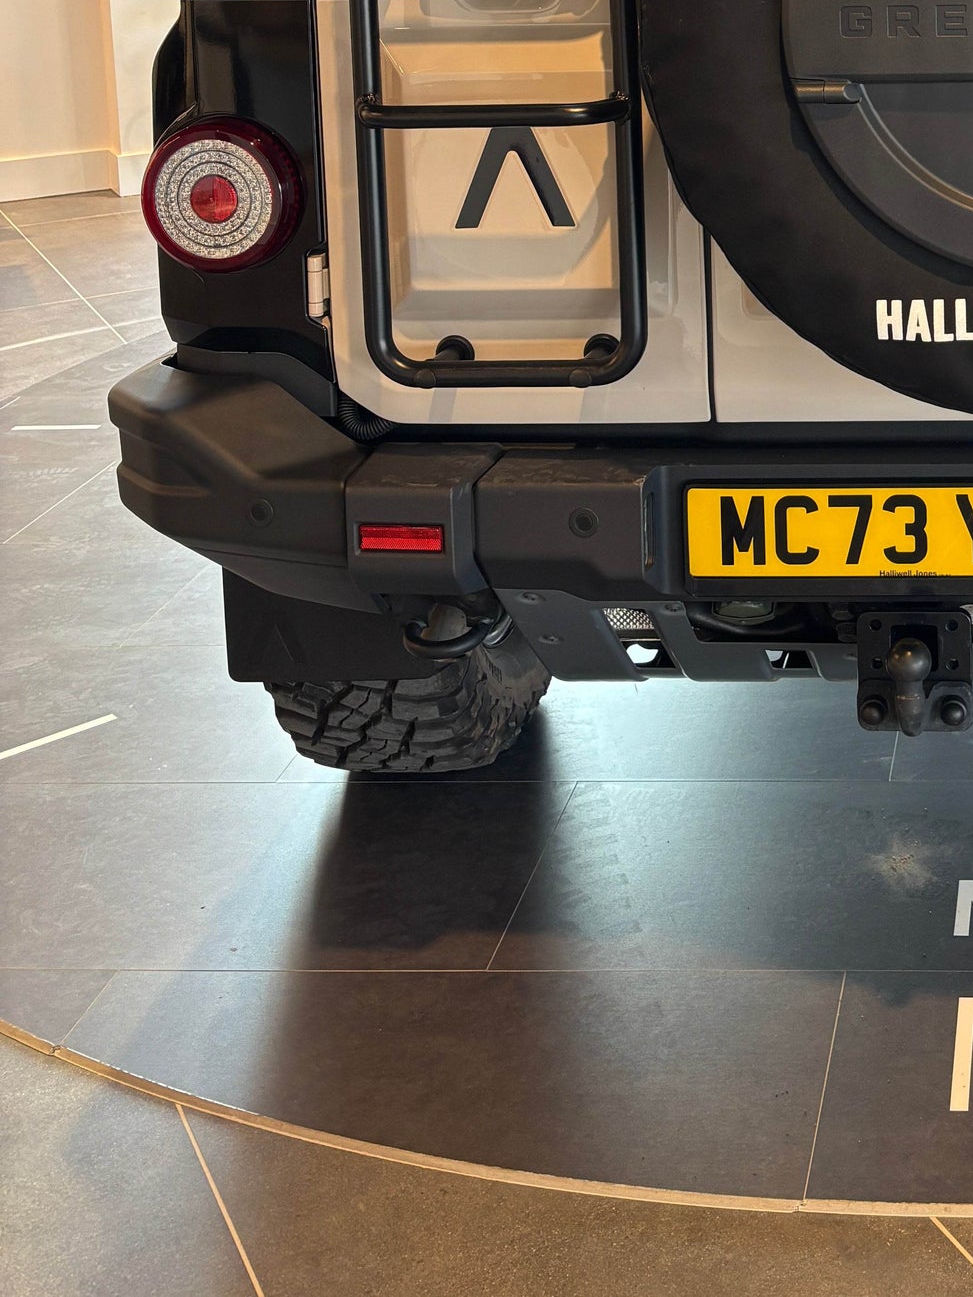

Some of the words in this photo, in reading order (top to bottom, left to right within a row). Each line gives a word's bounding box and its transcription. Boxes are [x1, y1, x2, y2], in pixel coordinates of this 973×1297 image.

[720, 494, 928, 566] MC73
[879, 569, 912, 577] Halliwell
[914, 569, 938, 577] Jones
